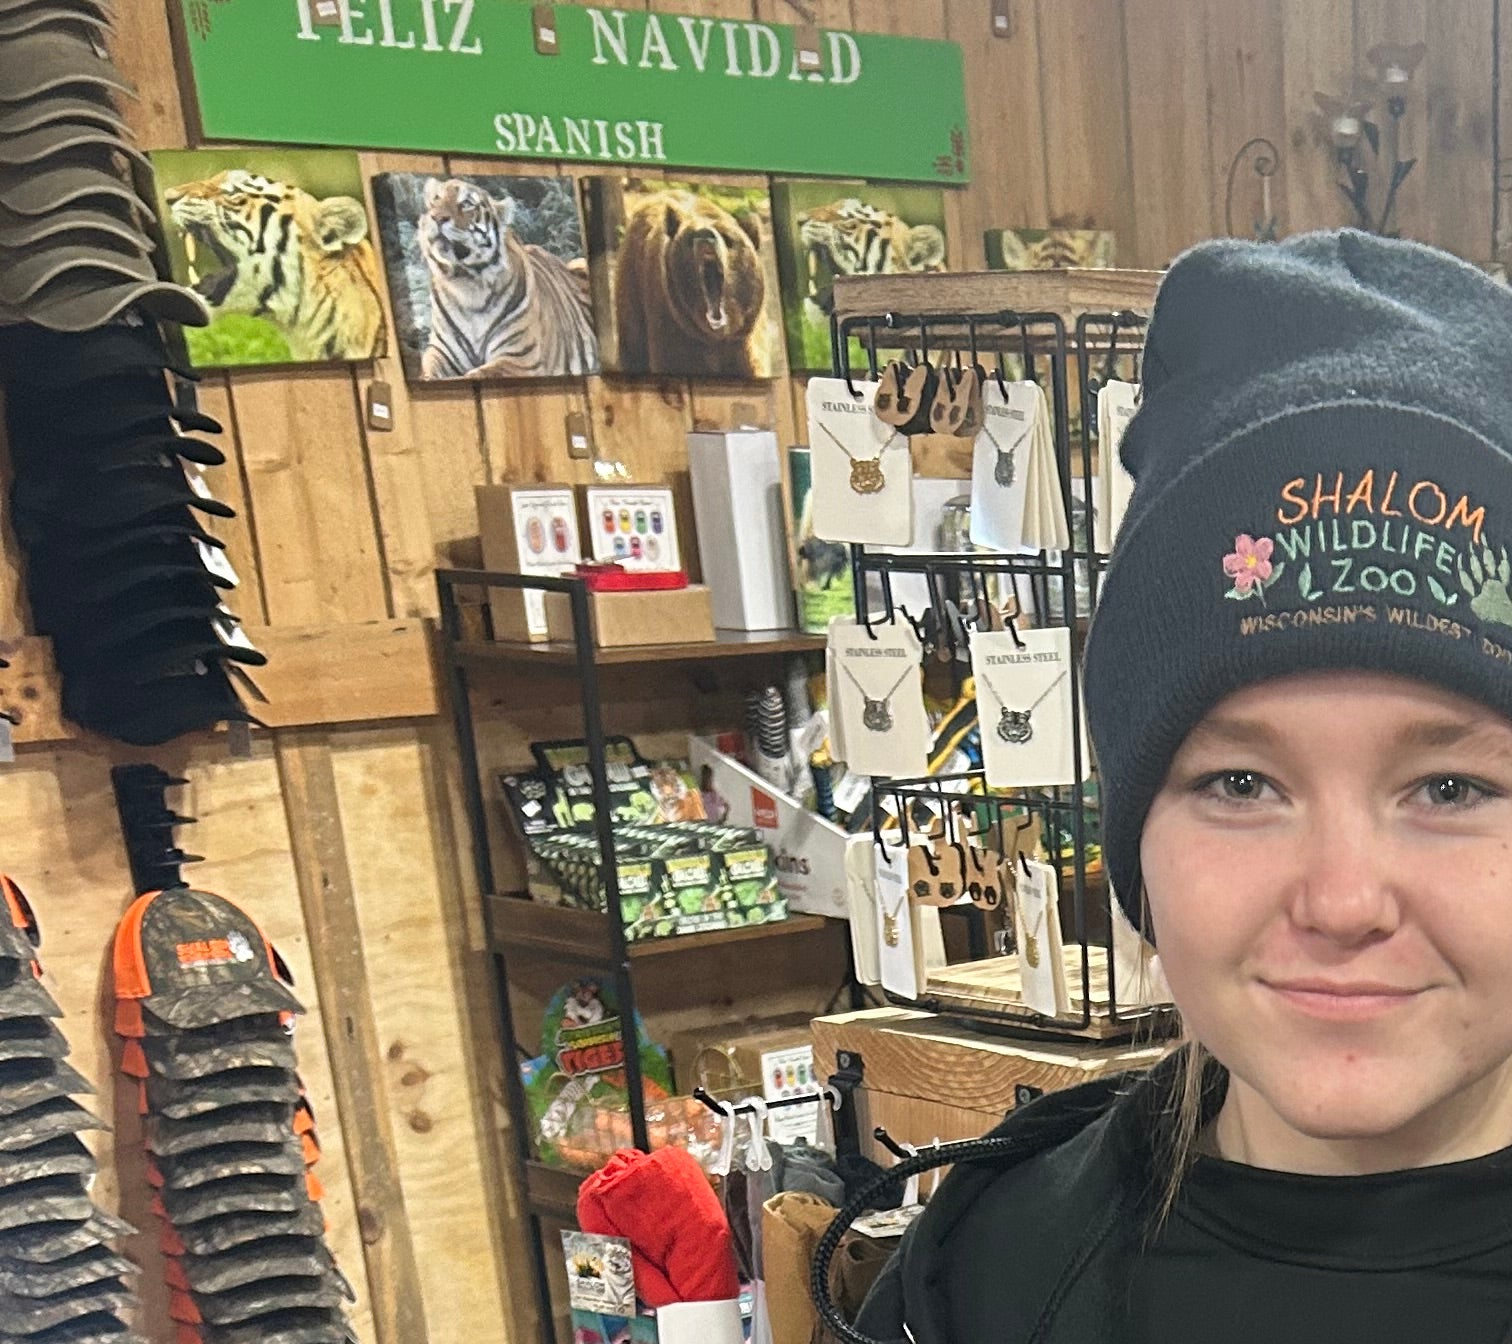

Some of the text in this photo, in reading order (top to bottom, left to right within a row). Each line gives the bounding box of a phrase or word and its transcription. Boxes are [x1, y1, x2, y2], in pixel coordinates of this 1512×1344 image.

[587, 8, 861, 84] NAVIDD
[494, 113, 667, 160] SPANISH
[1277, 469, 1486, 545] SHALOM
[1276, 518, 1456, 574] WILDLIFE
[1331, 558, 1416, 596] ZOO
[1240, 605, 1377, 637] WISCONSIN'S
[1387, 606, 1472, 640] WILDEST
